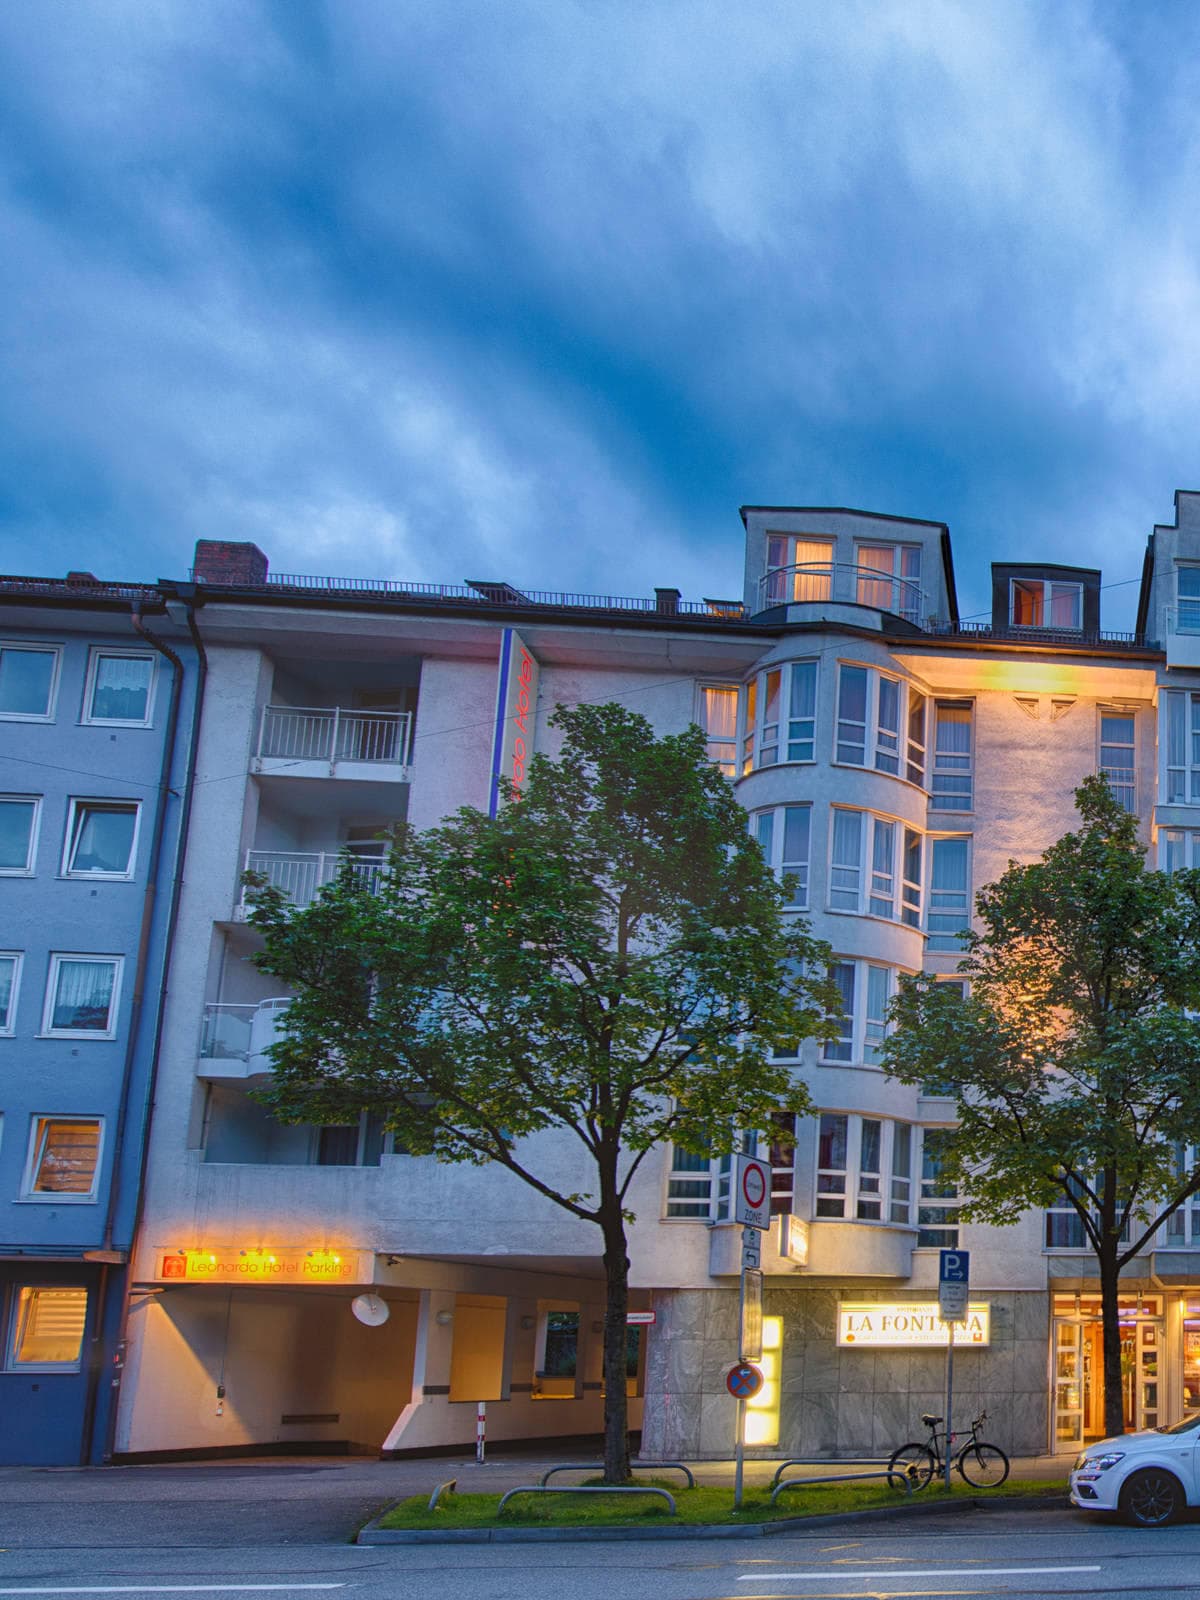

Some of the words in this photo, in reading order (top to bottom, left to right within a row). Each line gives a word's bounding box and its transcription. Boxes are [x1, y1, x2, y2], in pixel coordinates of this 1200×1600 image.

[513, 647, 533, 734] Hotel
[744, 1209, 763, 1225] ZONE
[191, 1260, 259, 1274] Leonardo
[263, 1261, 299, 1274] Hotel
[303, 1262, 352, 1276] Parking
[944, 1254, 961, 1278] P
[847, 1315, 873, 1331] LA
